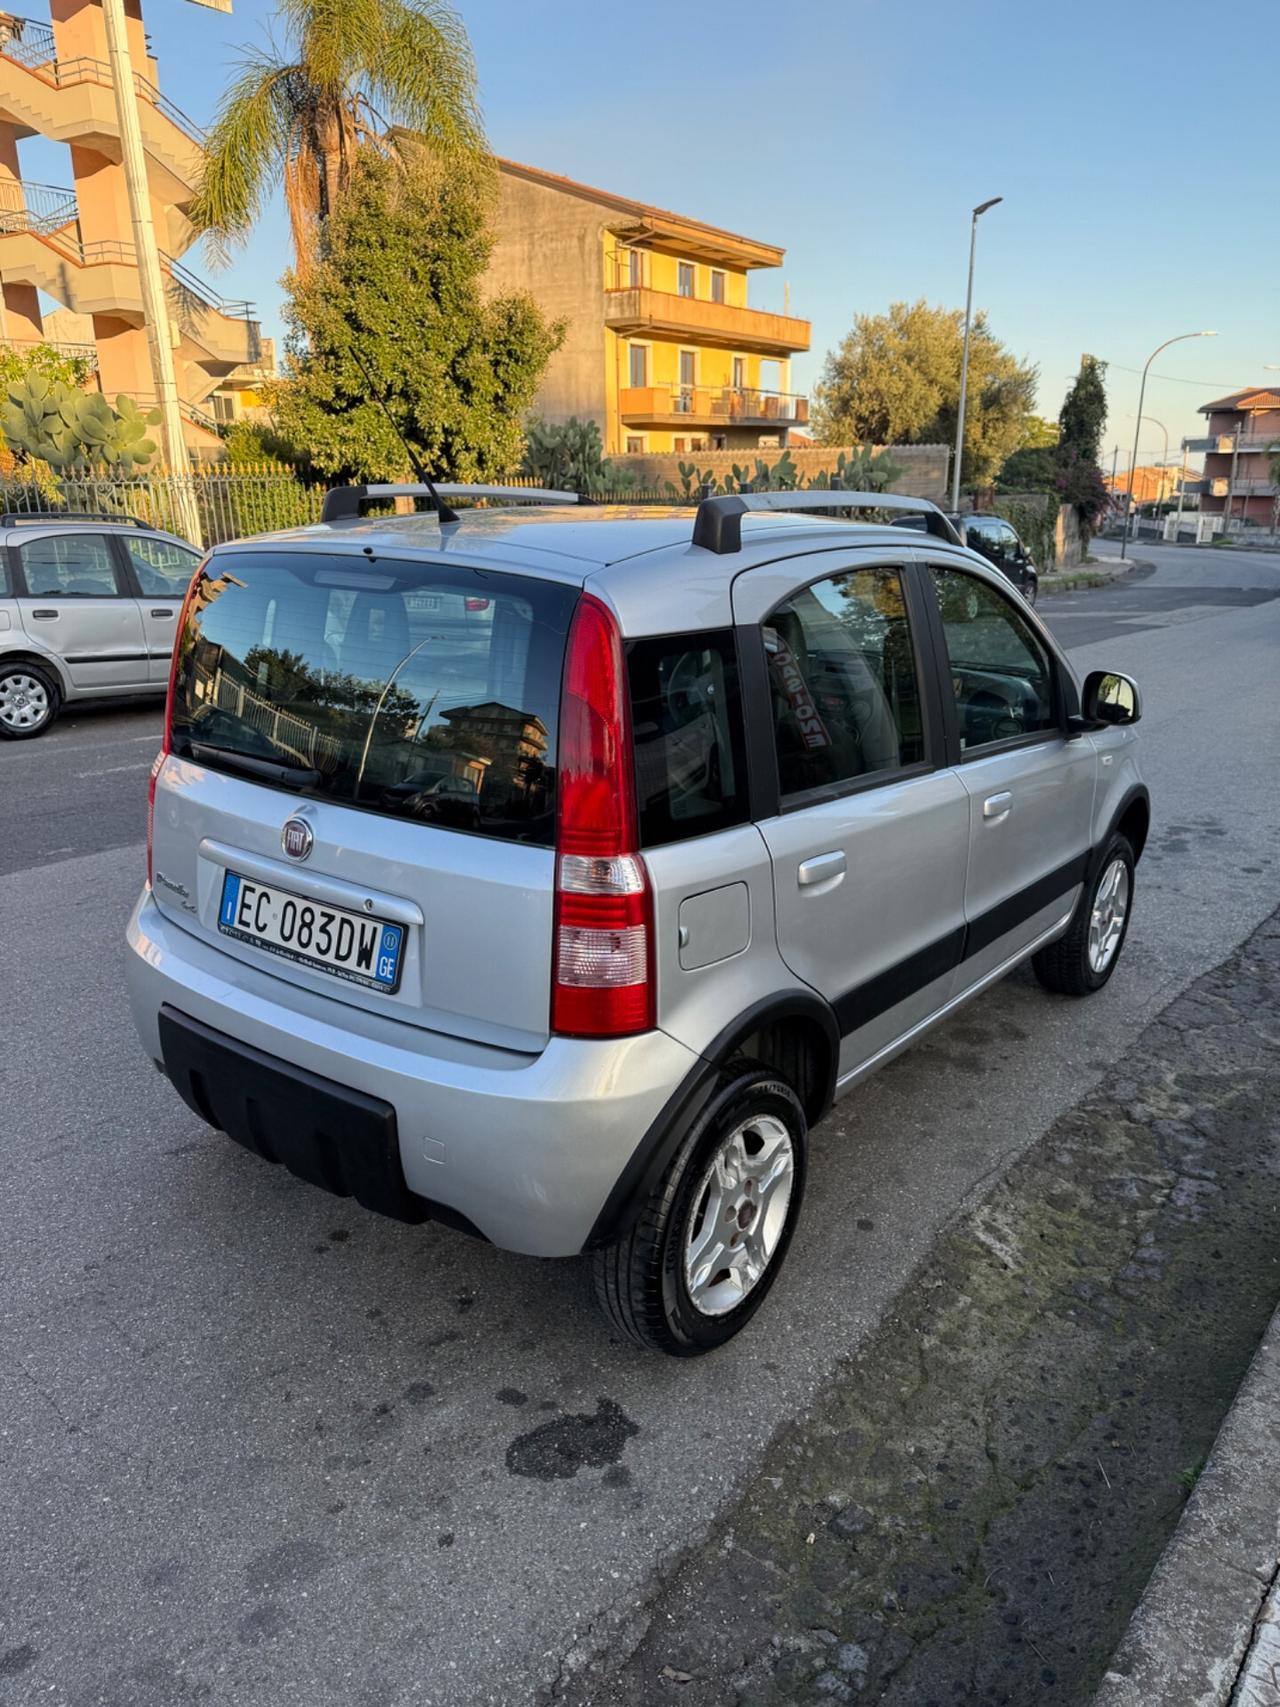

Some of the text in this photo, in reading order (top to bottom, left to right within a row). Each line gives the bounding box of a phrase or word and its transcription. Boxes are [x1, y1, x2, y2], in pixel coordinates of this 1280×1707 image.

[286, 829, 305, 852] FIAT
[238, 884, 271, 932] EC
[280, 900, 378, 971] 083DW
[379, 956, 395, 979] GE
